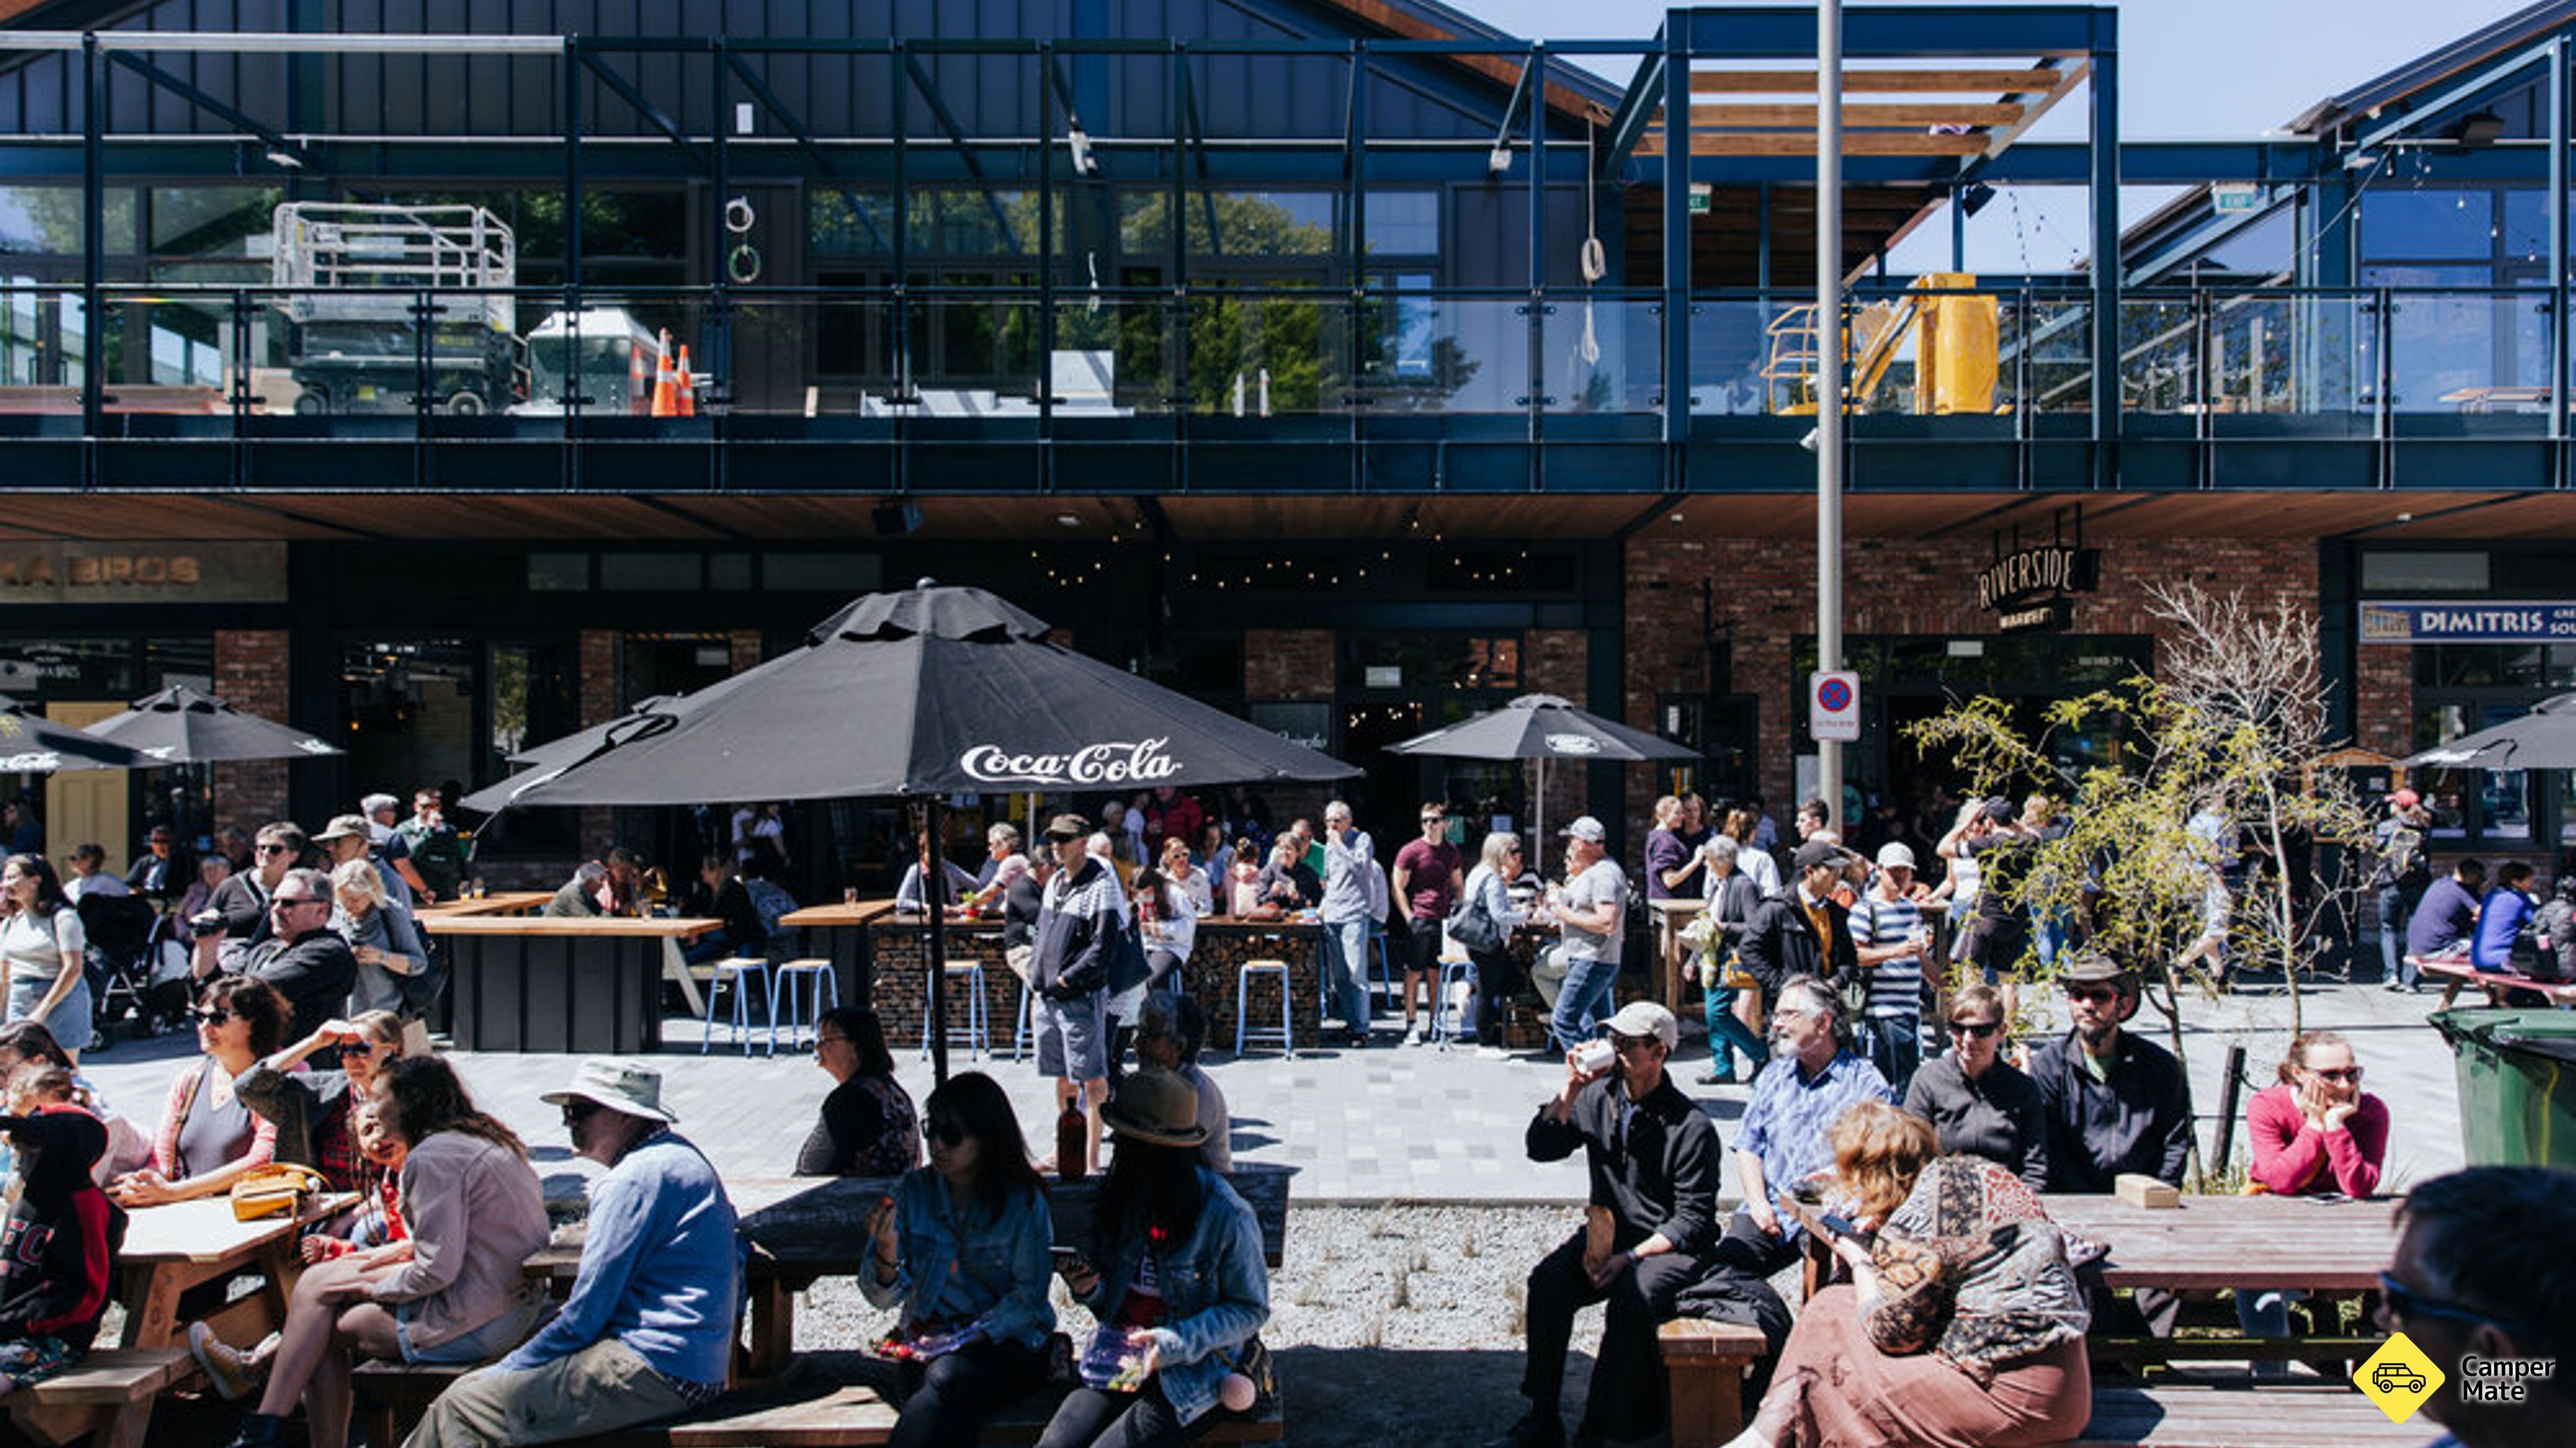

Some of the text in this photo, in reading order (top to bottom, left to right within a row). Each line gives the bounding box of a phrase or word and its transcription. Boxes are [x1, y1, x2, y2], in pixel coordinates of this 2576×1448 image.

[70, 555, 200, 586] BROS
[1979, 548, 2074, 609] RIVERSIDE
[2420, 611, 2543, 633] DIMITRIS
[960, 736, 1183, 784] Coca-Cola
